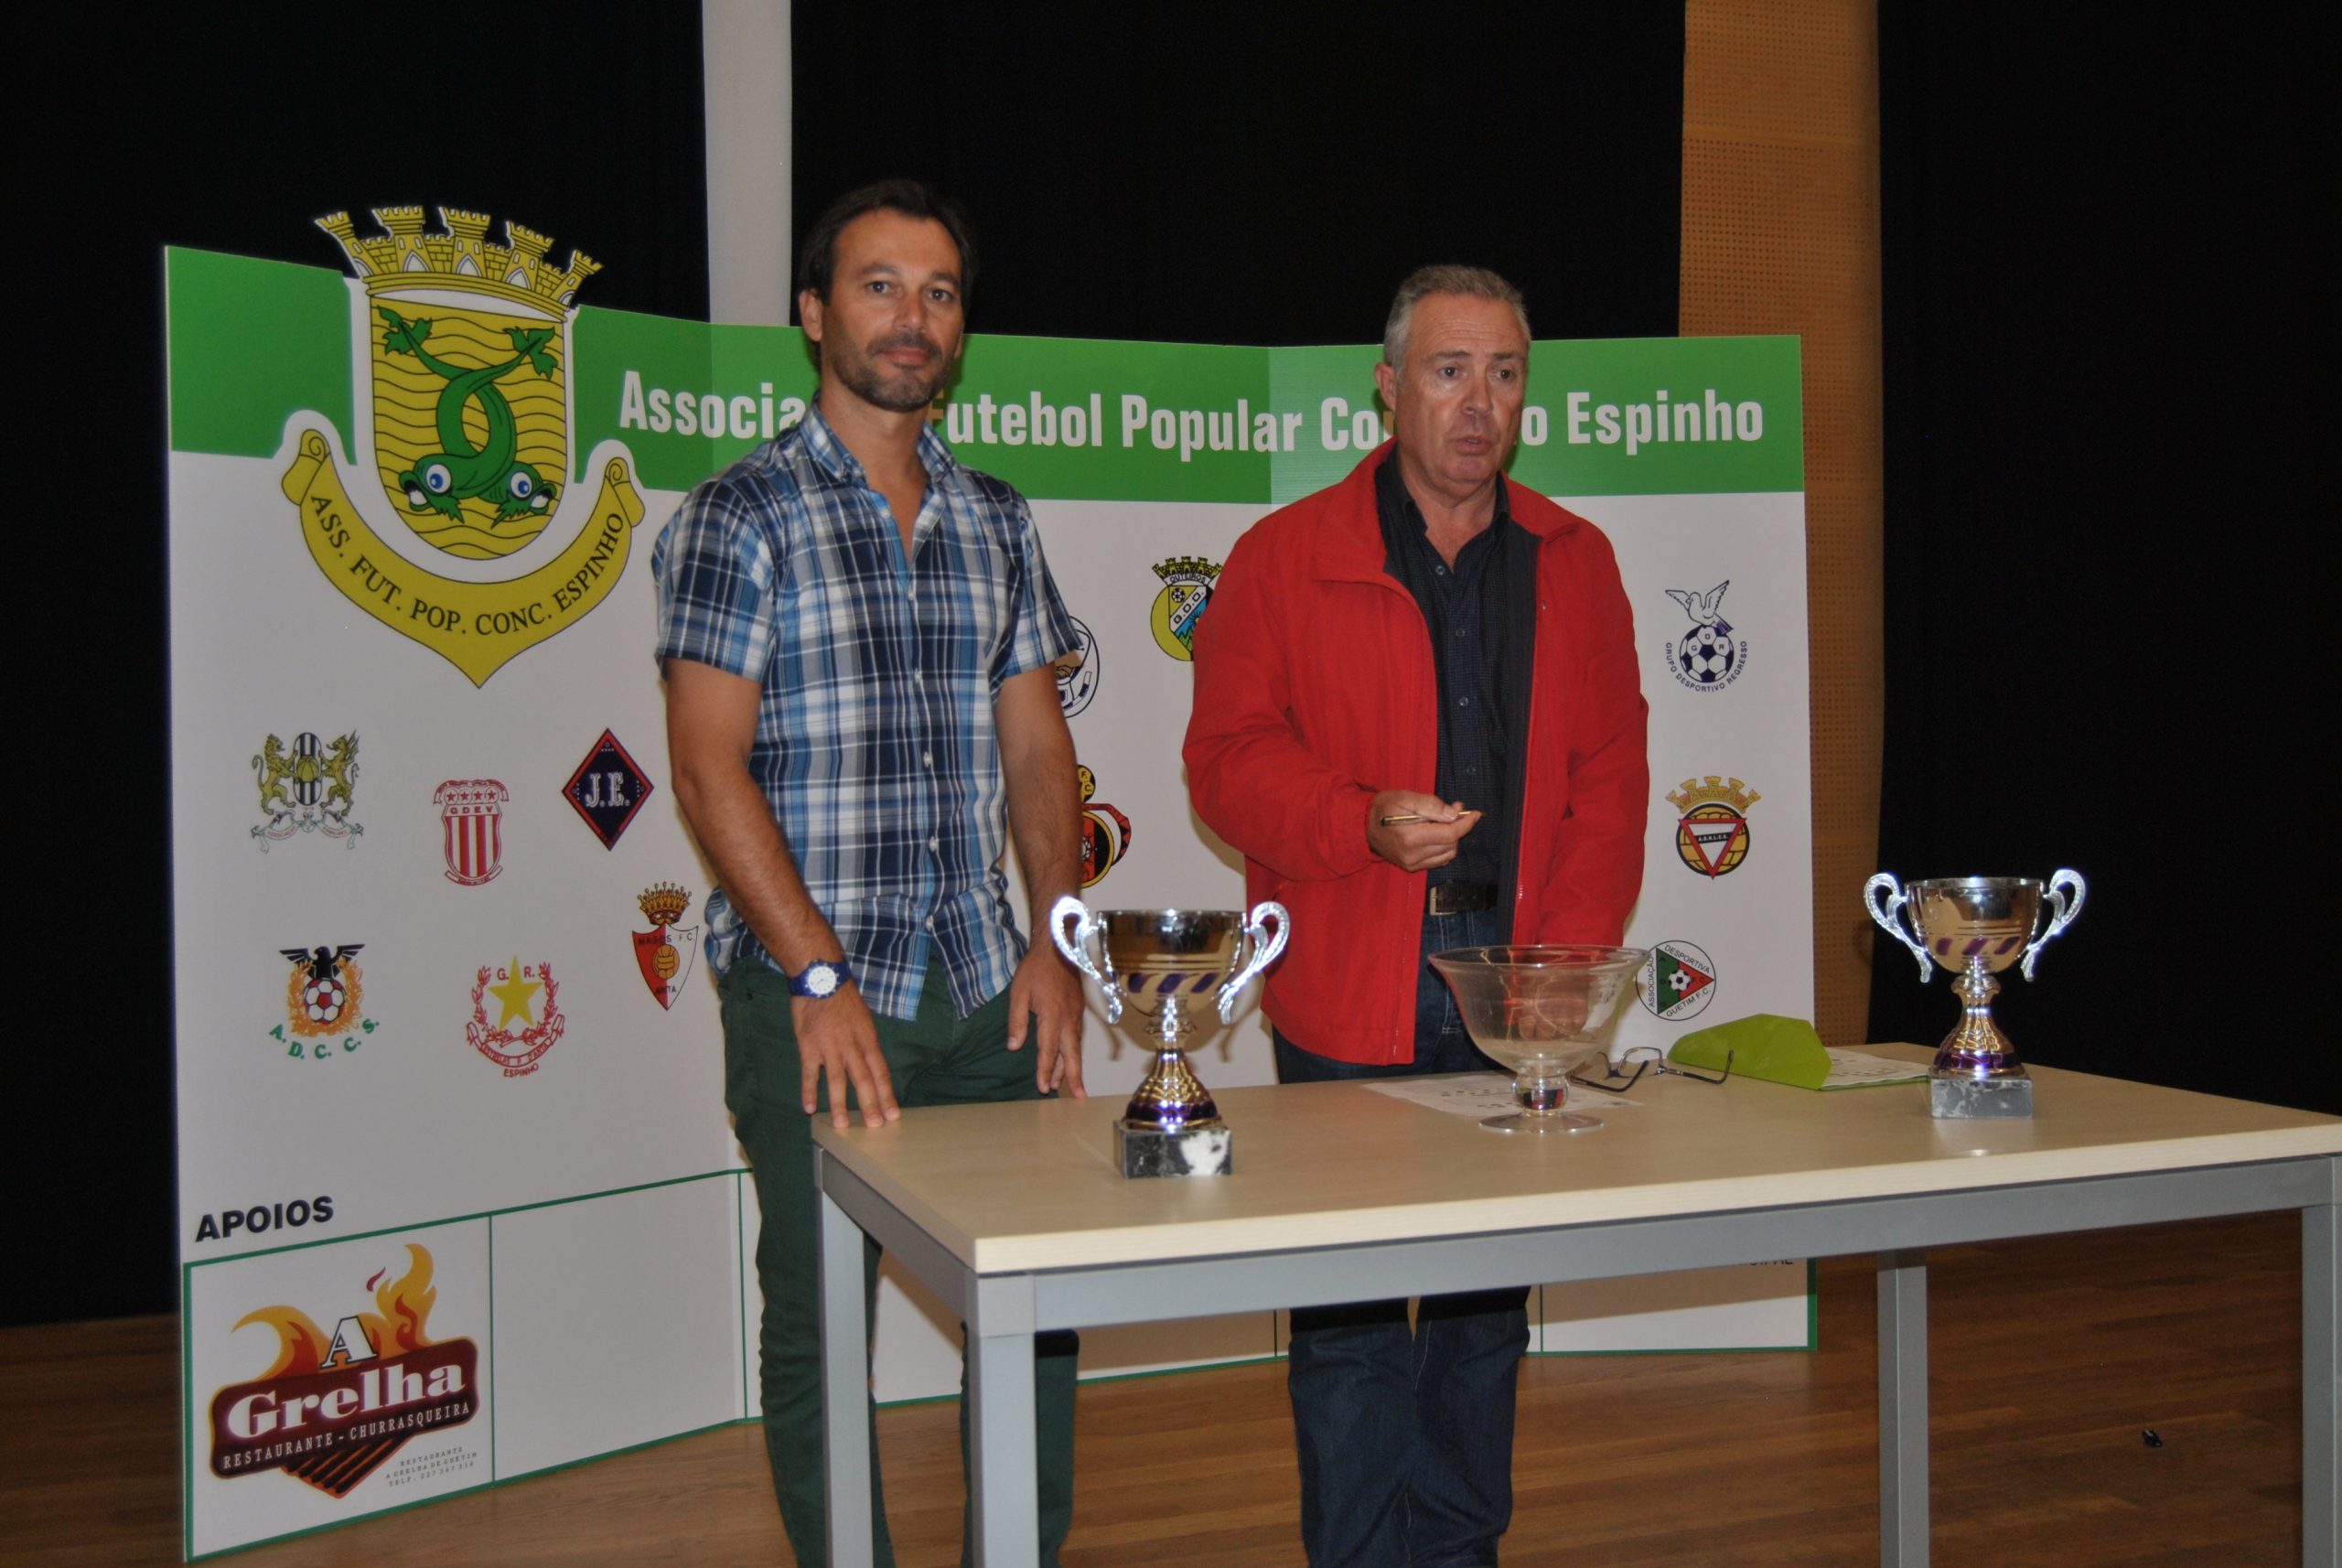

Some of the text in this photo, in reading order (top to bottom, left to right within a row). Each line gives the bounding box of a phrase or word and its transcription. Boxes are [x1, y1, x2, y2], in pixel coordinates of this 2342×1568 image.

[619, 370, 806, 439] Associa
[1122, 393, 1302, 462] Popular
[1320, 396, 1394, 450] Co
[1566, 389, 1763, 456] Espinho
[311, 494, 624, 636] ASS. FUT. POP. CONC. ESPINHO
[1665, 642, 1677, 673] GRUPO
[1675, 672, 1726, 693] DESPORTIVO
[1664, 944, 1710, 974] DESPORTIVA
[1666, 995, 1697, 1017] GUETIM
[503, 1062, 540, 1078] ESPINHO
[195, 1195, 334, 1242] APOIOS
[320, 1315, 377, 1369] A
[228, 1362, 467, 1439] Grelha
[223, 1432, 333, 1469] RESTAURANTE
[349, 1402, 470, 1441] CHURRASQUEIRA
